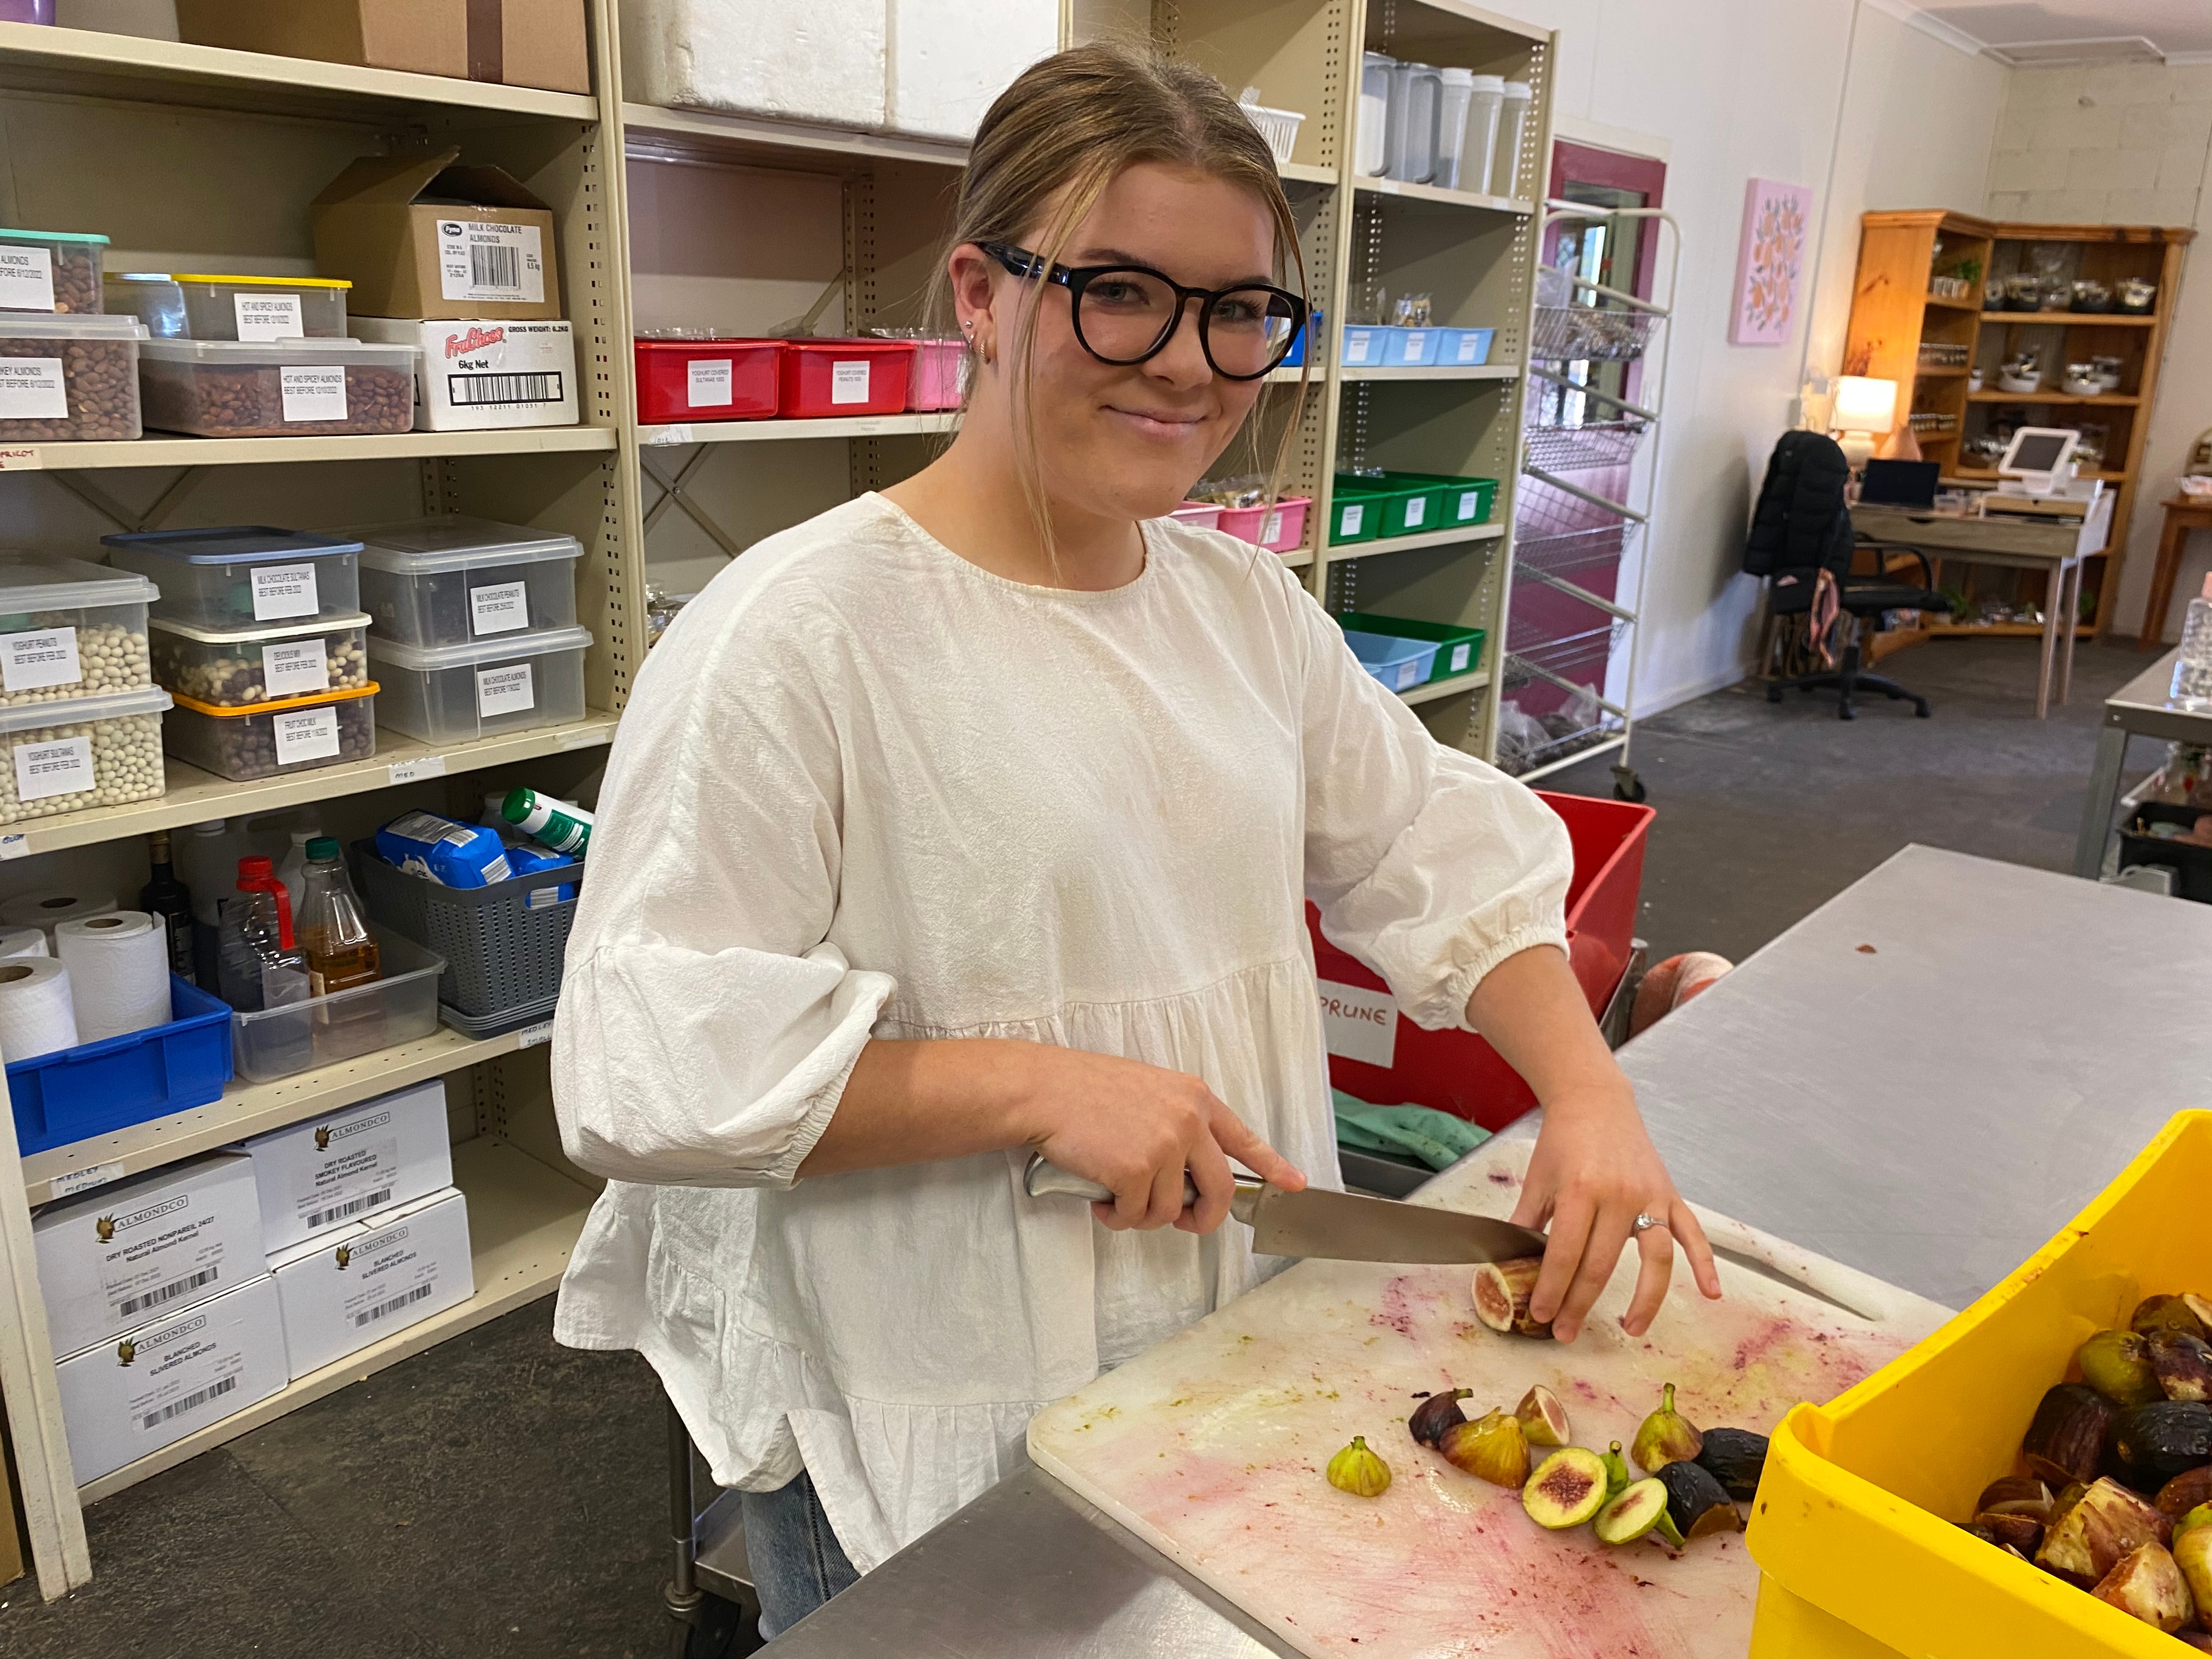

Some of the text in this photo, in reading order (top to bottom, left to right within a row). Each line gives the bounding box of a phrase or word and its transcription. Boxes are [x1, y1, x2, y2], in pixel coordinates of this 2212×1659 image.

[469, 223, 522, 234] MILK CHOCOLATE
[470, 234, 500, 243] ALMONDS
[1, 255, 29, 265] ALMONDS
[251, 302, 259, 311] AND
[259, 302, 273, 311] SPICEY
[274, 302, 293, 311] ALMONDS
[244, 315, 253, 324] BEST
[254, 315, 270, 324] BEFORE
[14, 367, 42, 375] ALMONDS
[459, 360, 489, 370] 6kg Net
[6, 379, 30, 388] BEFORE
[321, 375, 342, 383] ALMONDS
[257, 572, 309, 584] MILK CHOCOLATE SULTANAS
[259, 588, 268, 596] BEST
[269, 586, 284, 596] BEFORE
[485, 591, 504, 601] CHOCOLATE
[504, 589, 519, 598] PEANUTS
[478, 605, 486, 613] BEST
[487, 603, 499, 612] BEFORE
[14, 654, 26, 664] BEST
[27, 652, 46, 663] BEFORE
[275, 664, 284, 672] BEST
[285, 662, 300, 671] BEFORE
[492, 674, 511, 684] CHOCOLATE
[511, 672, 526, 680] ALMONDS
[484, 688, 492, 696] BEST
[493, 686, 506, 695] BEFORE
[285, 720, 295, 729] FRUIT
[296, 719, 307, 727] CHOC
[286, 732, 295, 741] BEST
[296, 730, 311, 740] BEFORE
[29, 765, 41, 774] BEST
[42, 762, 60, 772] BEFORE
[331, 1115, 387, 1139] ALMONDCO
[324, 1150, 366, 1169] DRY ROASTED
[315, 1154, 377, 1180] SMOKEY FLAVOURED
[57, 1166, 98, 1182] MEDLEY
[315, 1162, 377, 1187] Natural Almond Kernel
[118, 1199, 184, 1229] ALMONDCO
[106, 1251, 121, 1262] DRY
[123, 1238, 156, 1255] ROASTED
[158, 1224, 196, 1243] NONPAREIL
[126, 1231, 199, 1262] Natural Almond Kernel
[352, 1230, 405, 1257] ALMONDCO
[374, 1250, 403, 1267] BLANCHED
[362, 1252, 416, 1279] SLIVERED ALMONDS
[138, 1319, 202, 1352] ALMONDCO
[164, 1342, 200, 1361] BLANCHED
[150, 1342, 216, 1376] SLIVERED ALMONDS
